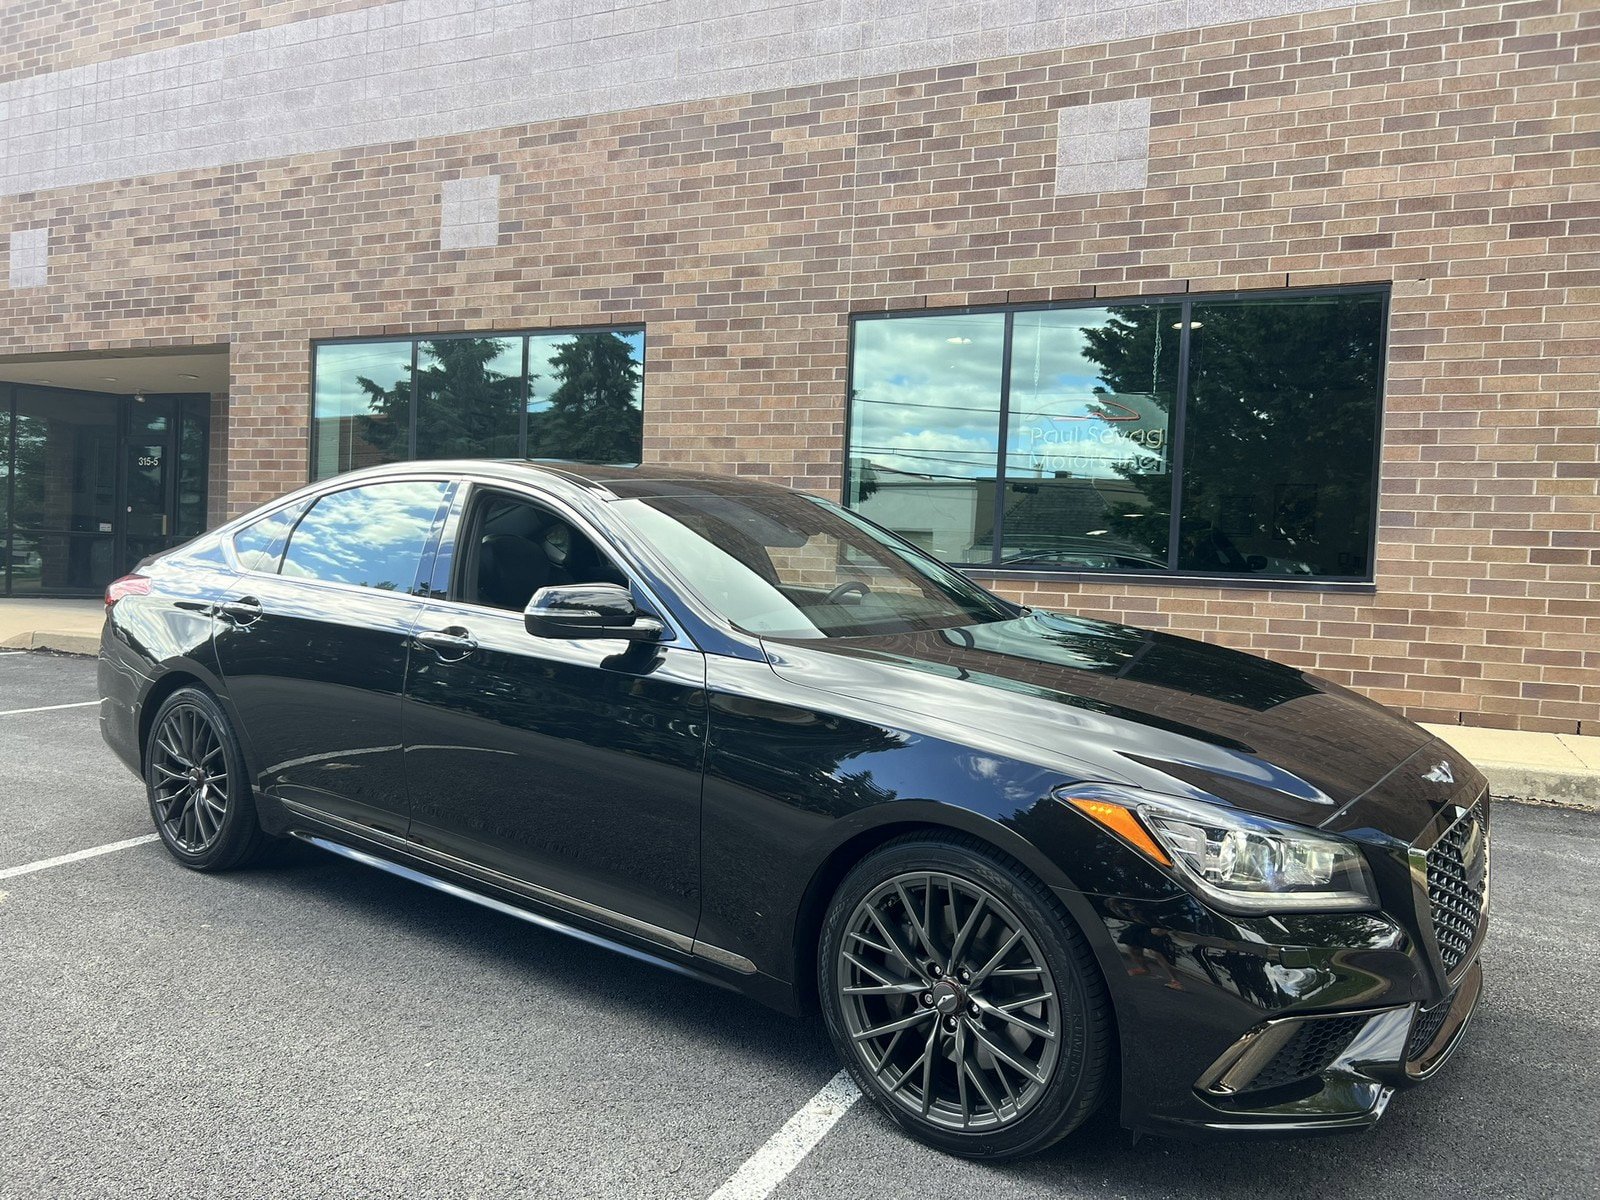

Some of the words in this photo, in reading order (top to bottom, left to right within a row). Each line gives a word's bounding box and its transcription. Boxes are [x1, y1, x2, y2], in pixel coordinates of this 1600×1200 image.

[1030, 426, 1079, 444] Paul
[1087, 425, 1164, 449] Sevag
[138, 456, 159, 466] 315-5
[1029, 450, 1107, 470] Motors
